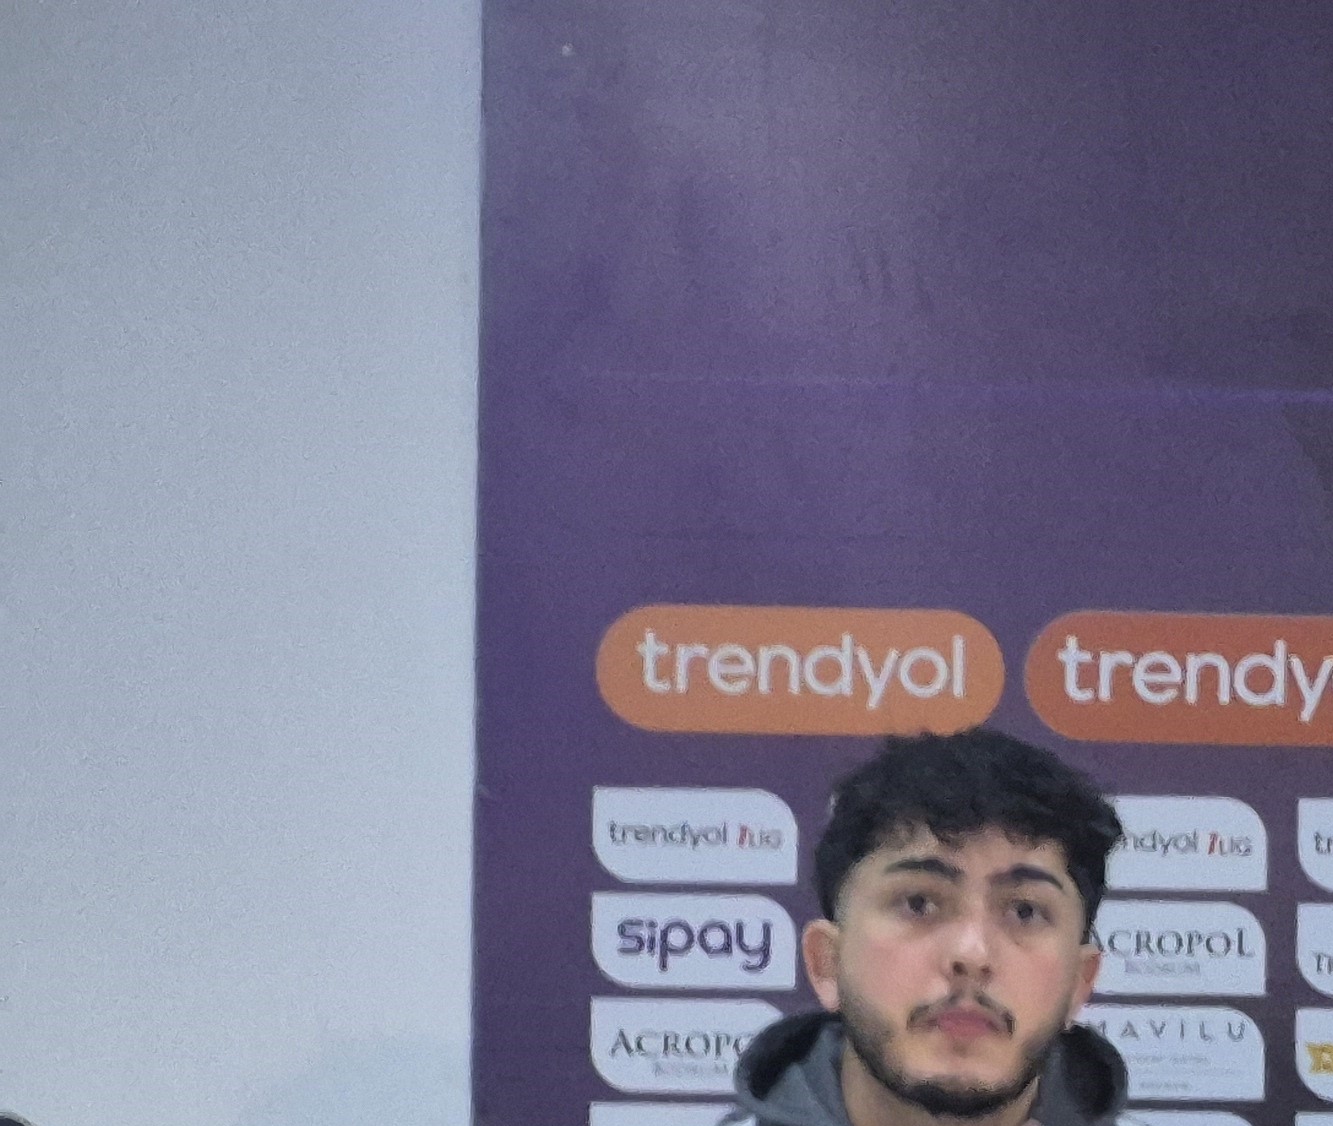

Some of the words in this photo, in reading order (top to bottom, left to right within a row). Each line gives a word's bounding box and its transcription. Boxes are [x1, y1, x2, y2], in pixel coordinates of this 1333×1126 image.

[637, 629, 965, 710] trendyol
[617, 919, 772, 973] sipay
[1101, 1020, 1246, 1042] AVILU
